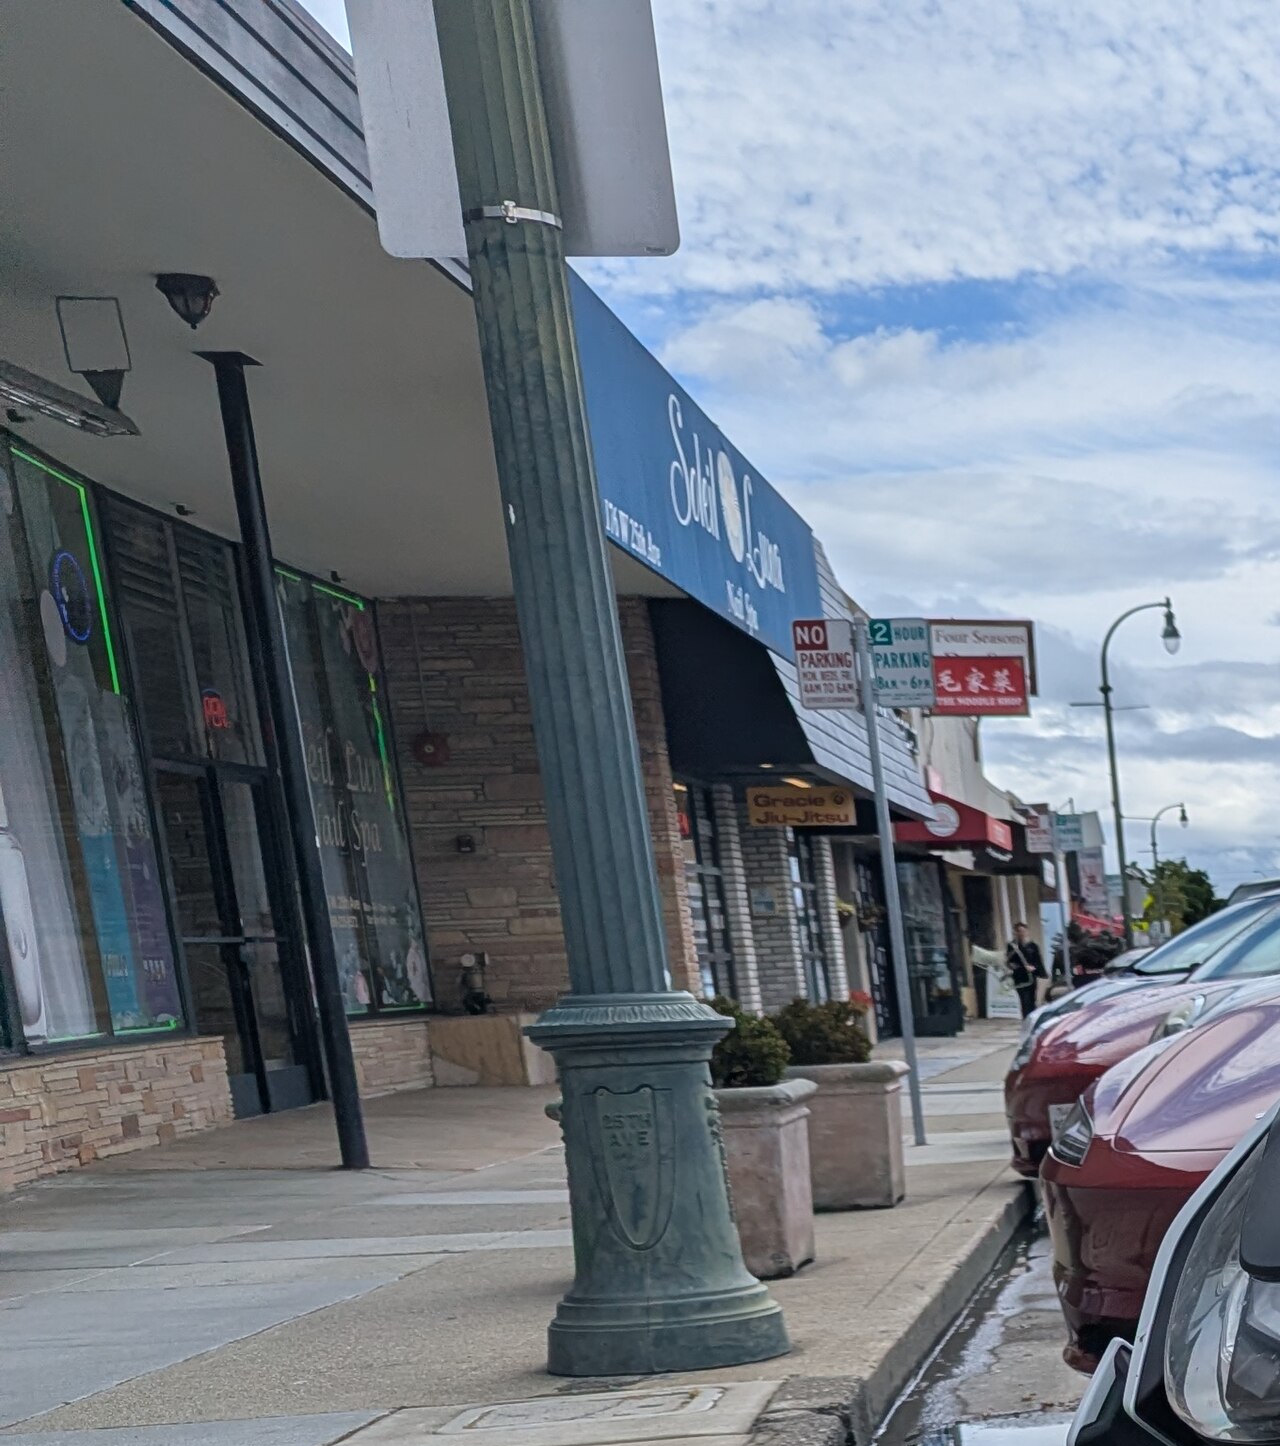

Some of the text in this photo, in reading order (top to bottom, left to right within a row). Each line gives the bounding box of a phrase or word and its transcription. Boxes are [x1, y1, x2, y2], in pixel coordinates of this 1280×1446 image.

[618, 510, 629, 545] W
[796, 626, 824, 645] NO
[873, 622, 924, 642] 2 HOUR
[936, 629, 967, 643] Four
[801, 652, 852, 668] PARKING
[875, 652, 929, 668] PARKING
[911, 676, 930, 689] 6PM
[753, 793, 825, 807] Gracie
[610, 1131, 650, 1147] AVE
